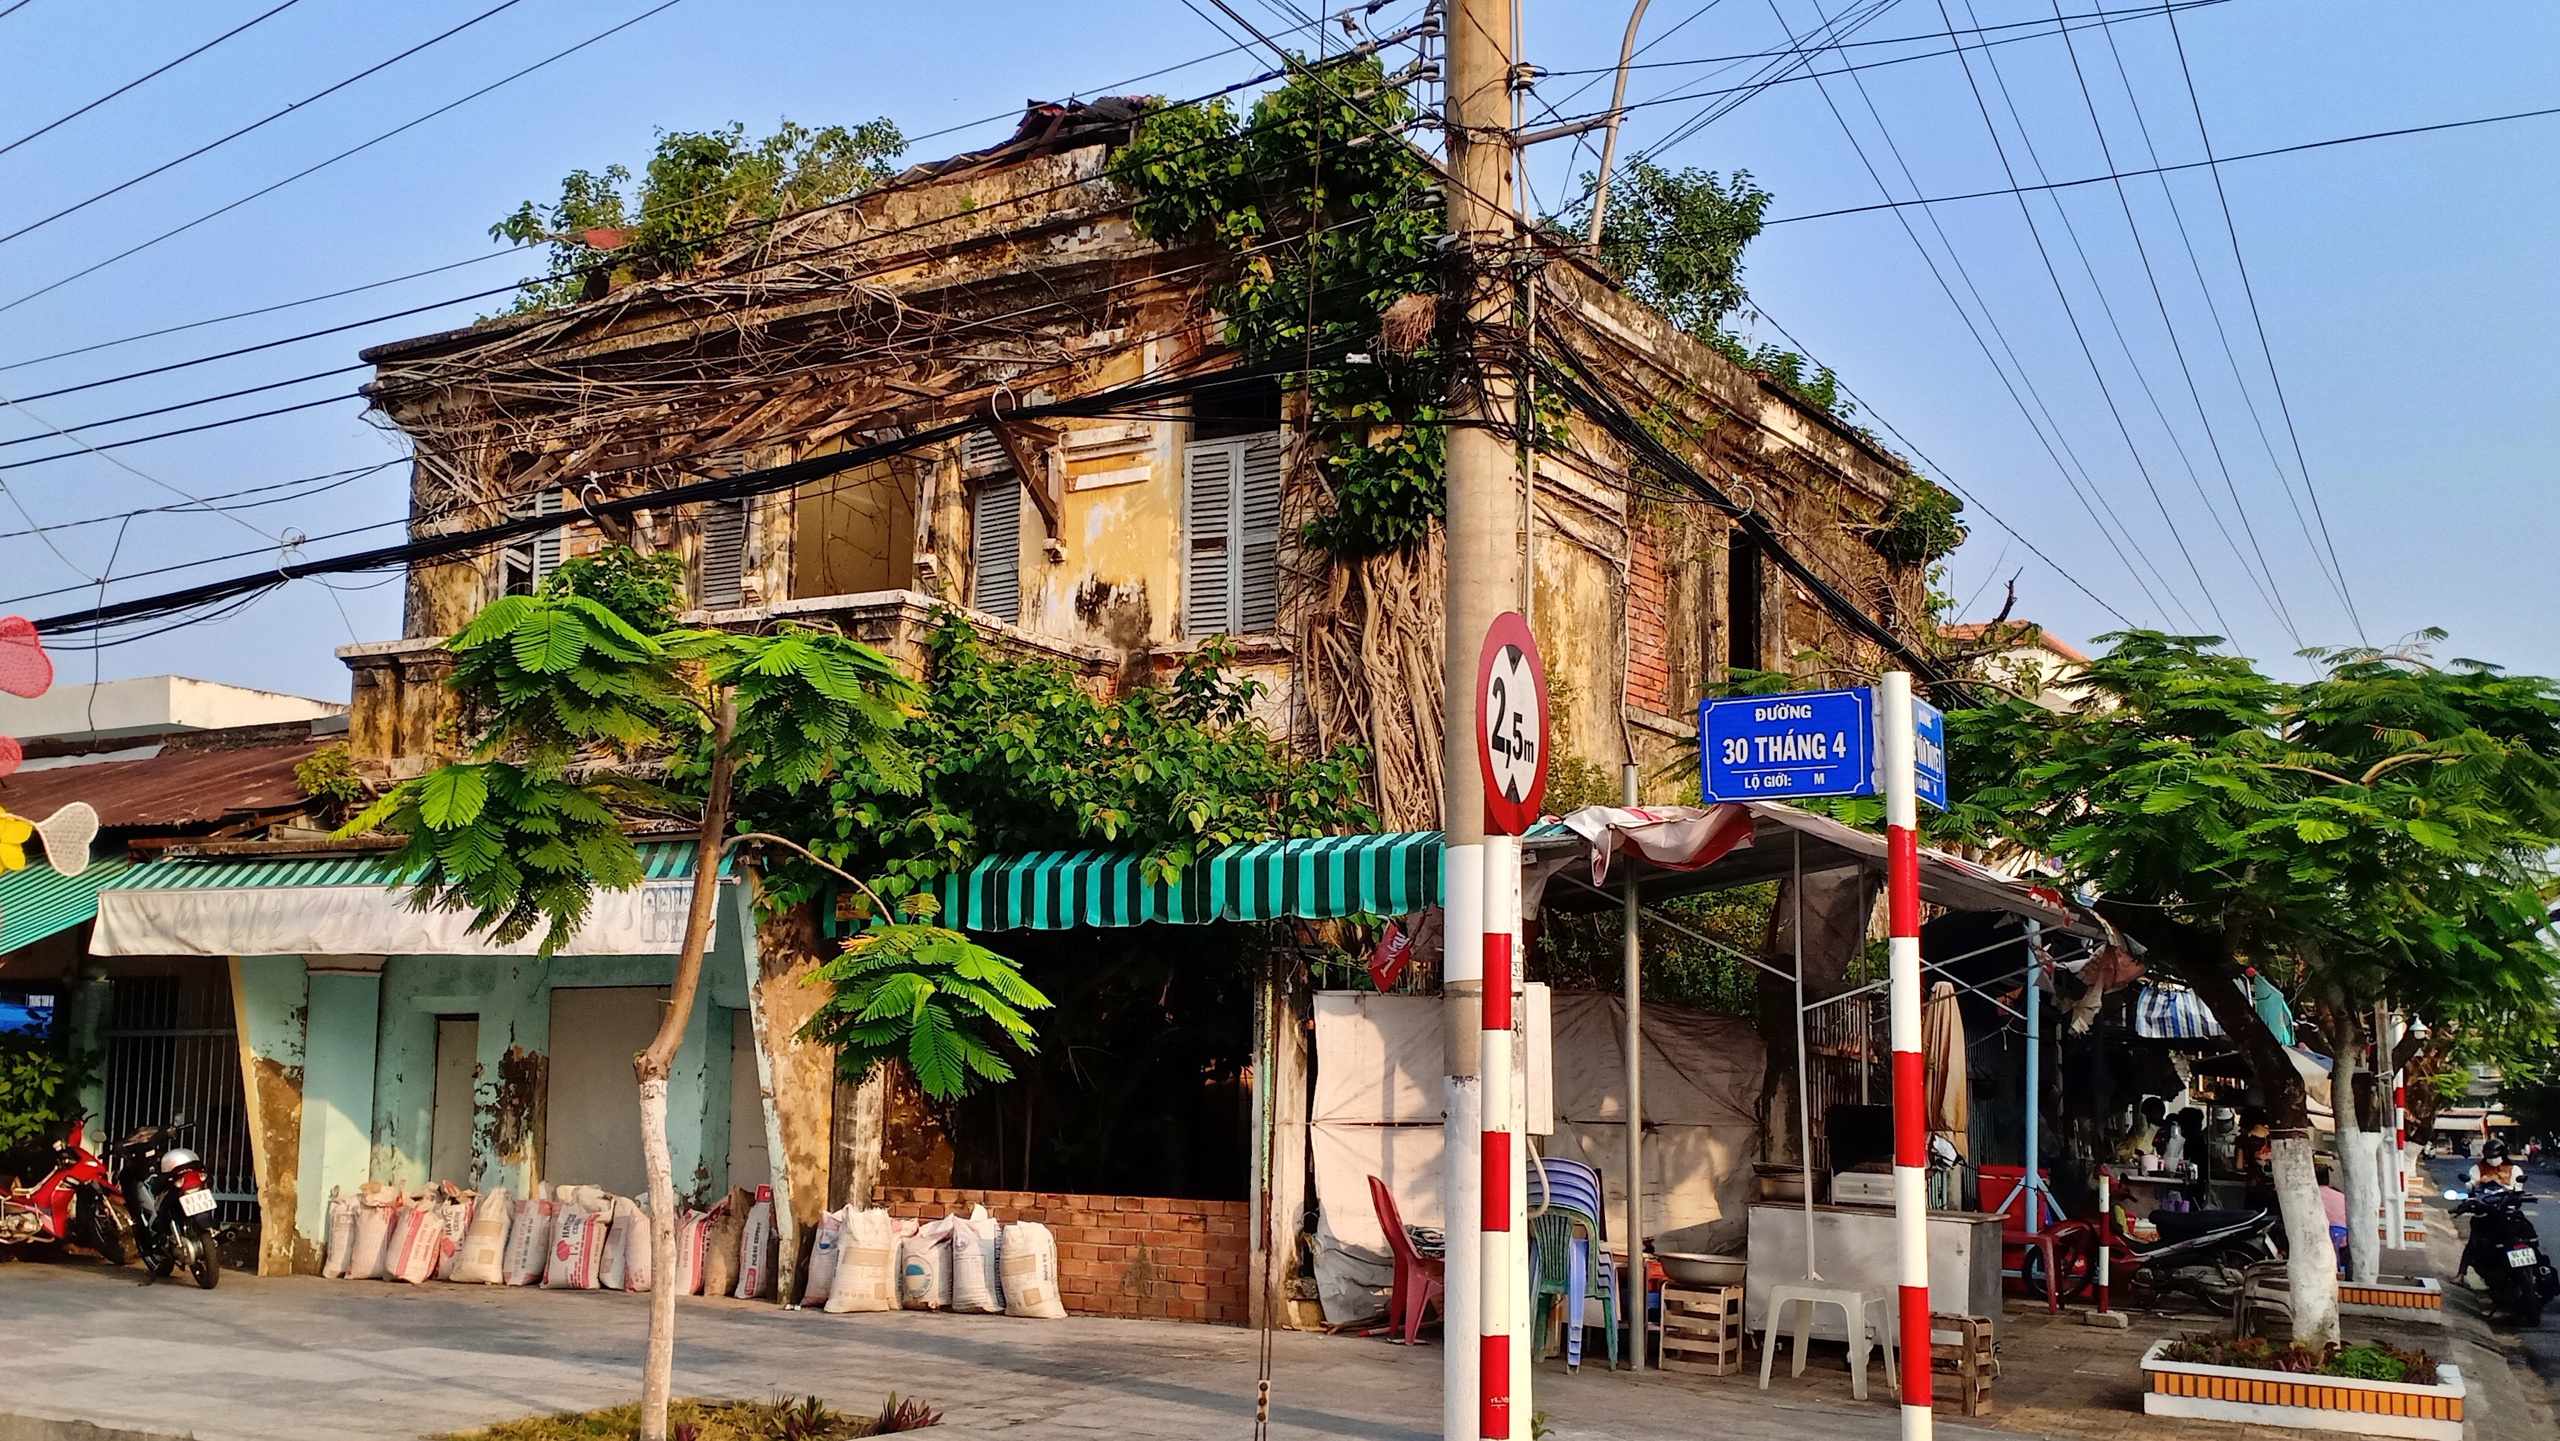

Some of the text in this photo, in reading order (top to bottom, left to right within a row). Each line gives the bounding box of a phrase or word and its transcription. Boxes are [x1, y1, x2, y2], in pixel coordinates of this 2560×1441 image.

[1755, 704, 1812, 722] ĐƯỜNG
[1722, 728, 1847, 765] 30 THÁNG 4
[1744, 772, 1826, 791] LỘ GIỚI: M
